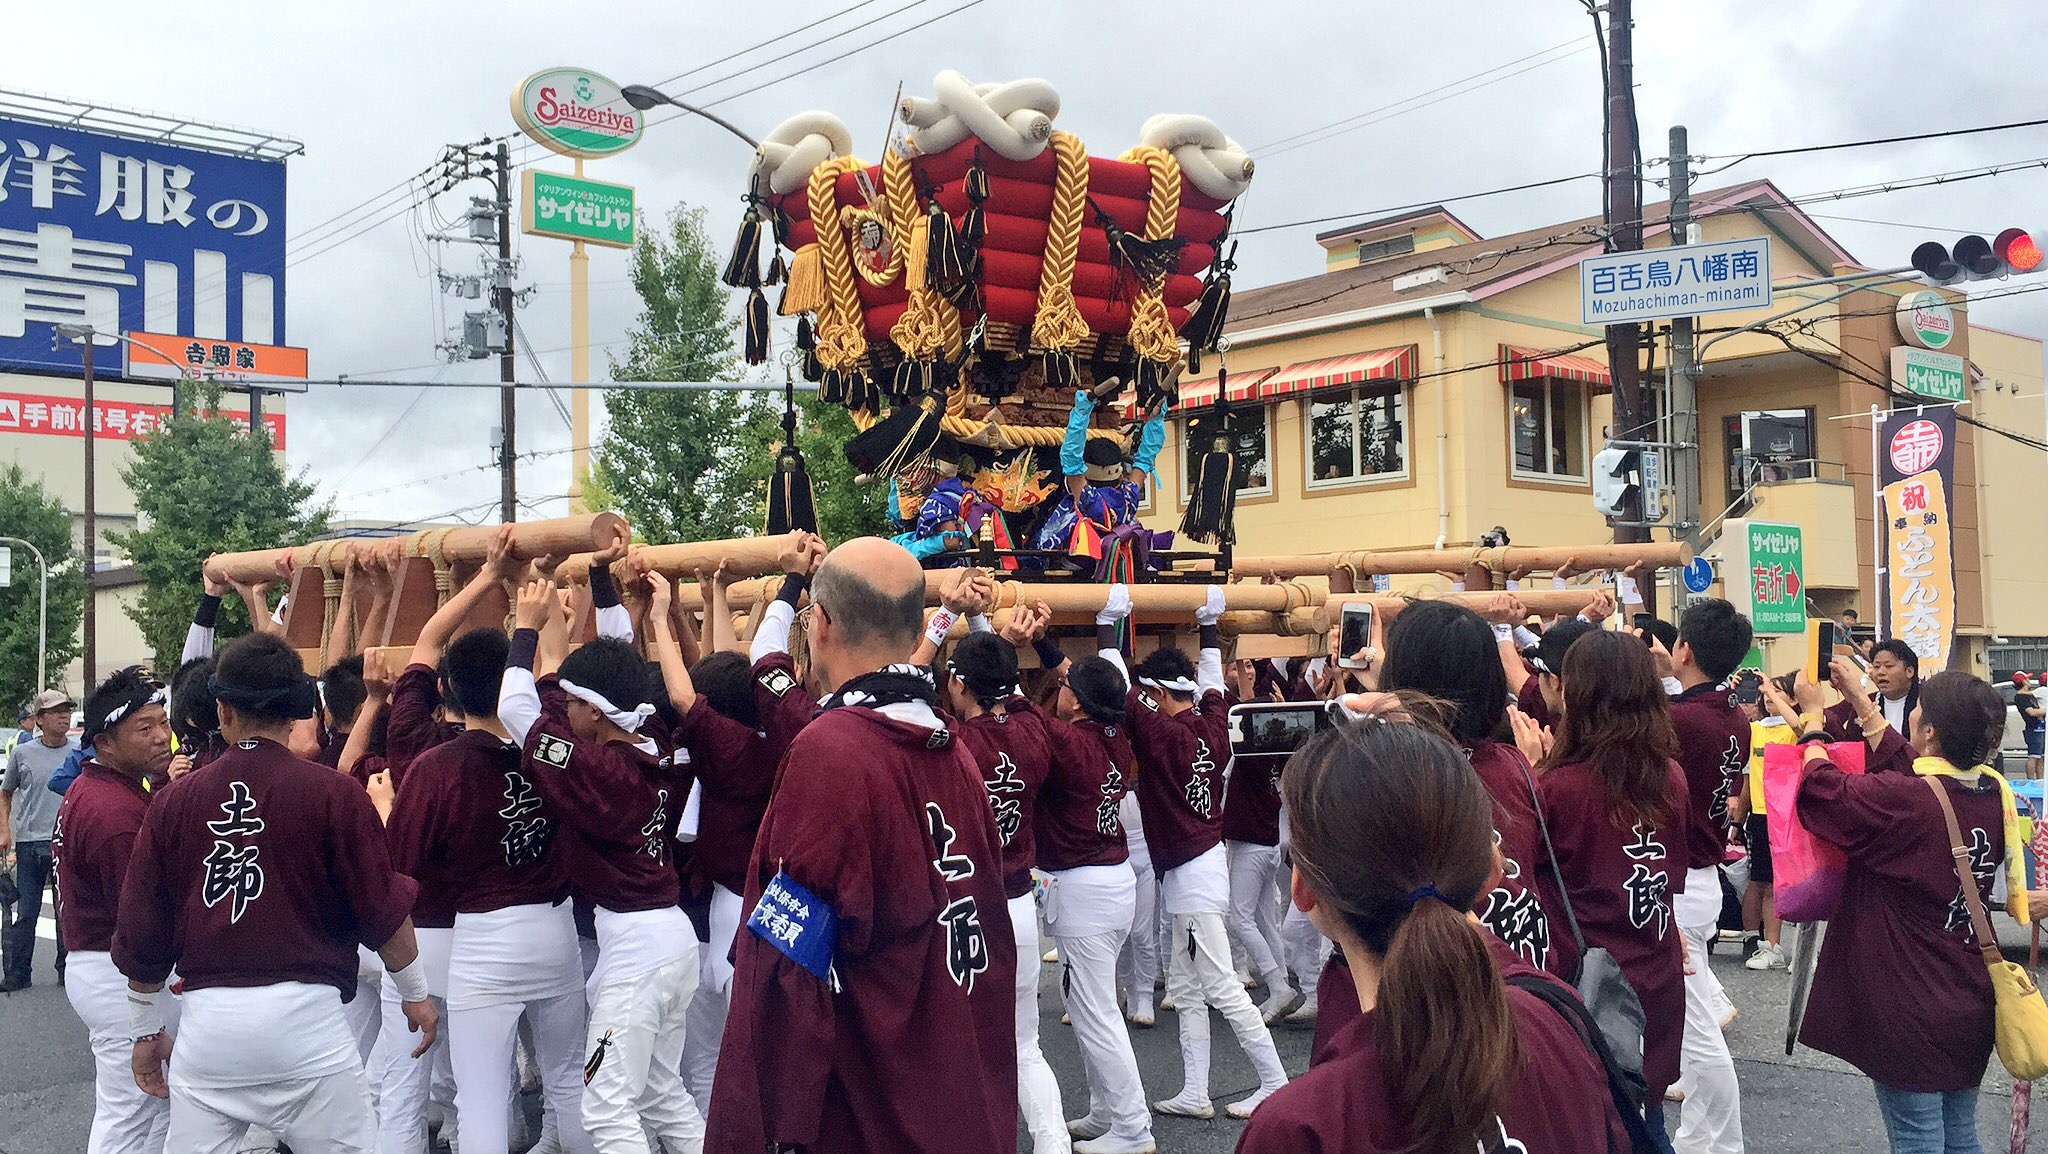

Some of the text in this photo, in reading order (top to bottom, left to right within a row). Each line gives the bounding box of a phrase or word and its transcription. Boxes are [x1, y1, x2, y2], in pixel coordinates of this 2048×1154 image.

[534, 87, 634, 131] Saizeriya
[0, 139, 269, 236] 洋服の
[538, 196, 631, 231] サイゼリヤ
[0, 223, 274, 346] 青山
[1592, 250, 1758, 294] 百舌鳥八幡南
[1592, 283, 1760, 314] Mozuhachiman-minami
[1915, 306, 1950, 330] Saizeriya
[1907, 365, 1962, 397] サイゼリヤ
[1903, 485, 1926, 511] 祝
[1752, 532, 1799, 555] サイゼリヤ
[1753, 561, 1784, 605] 右折
[1897, 526, 1940, 659] ふとん太鼓
[202, 781, 265, 925] 土師
[1622, 818, 1671, 942] 土師
